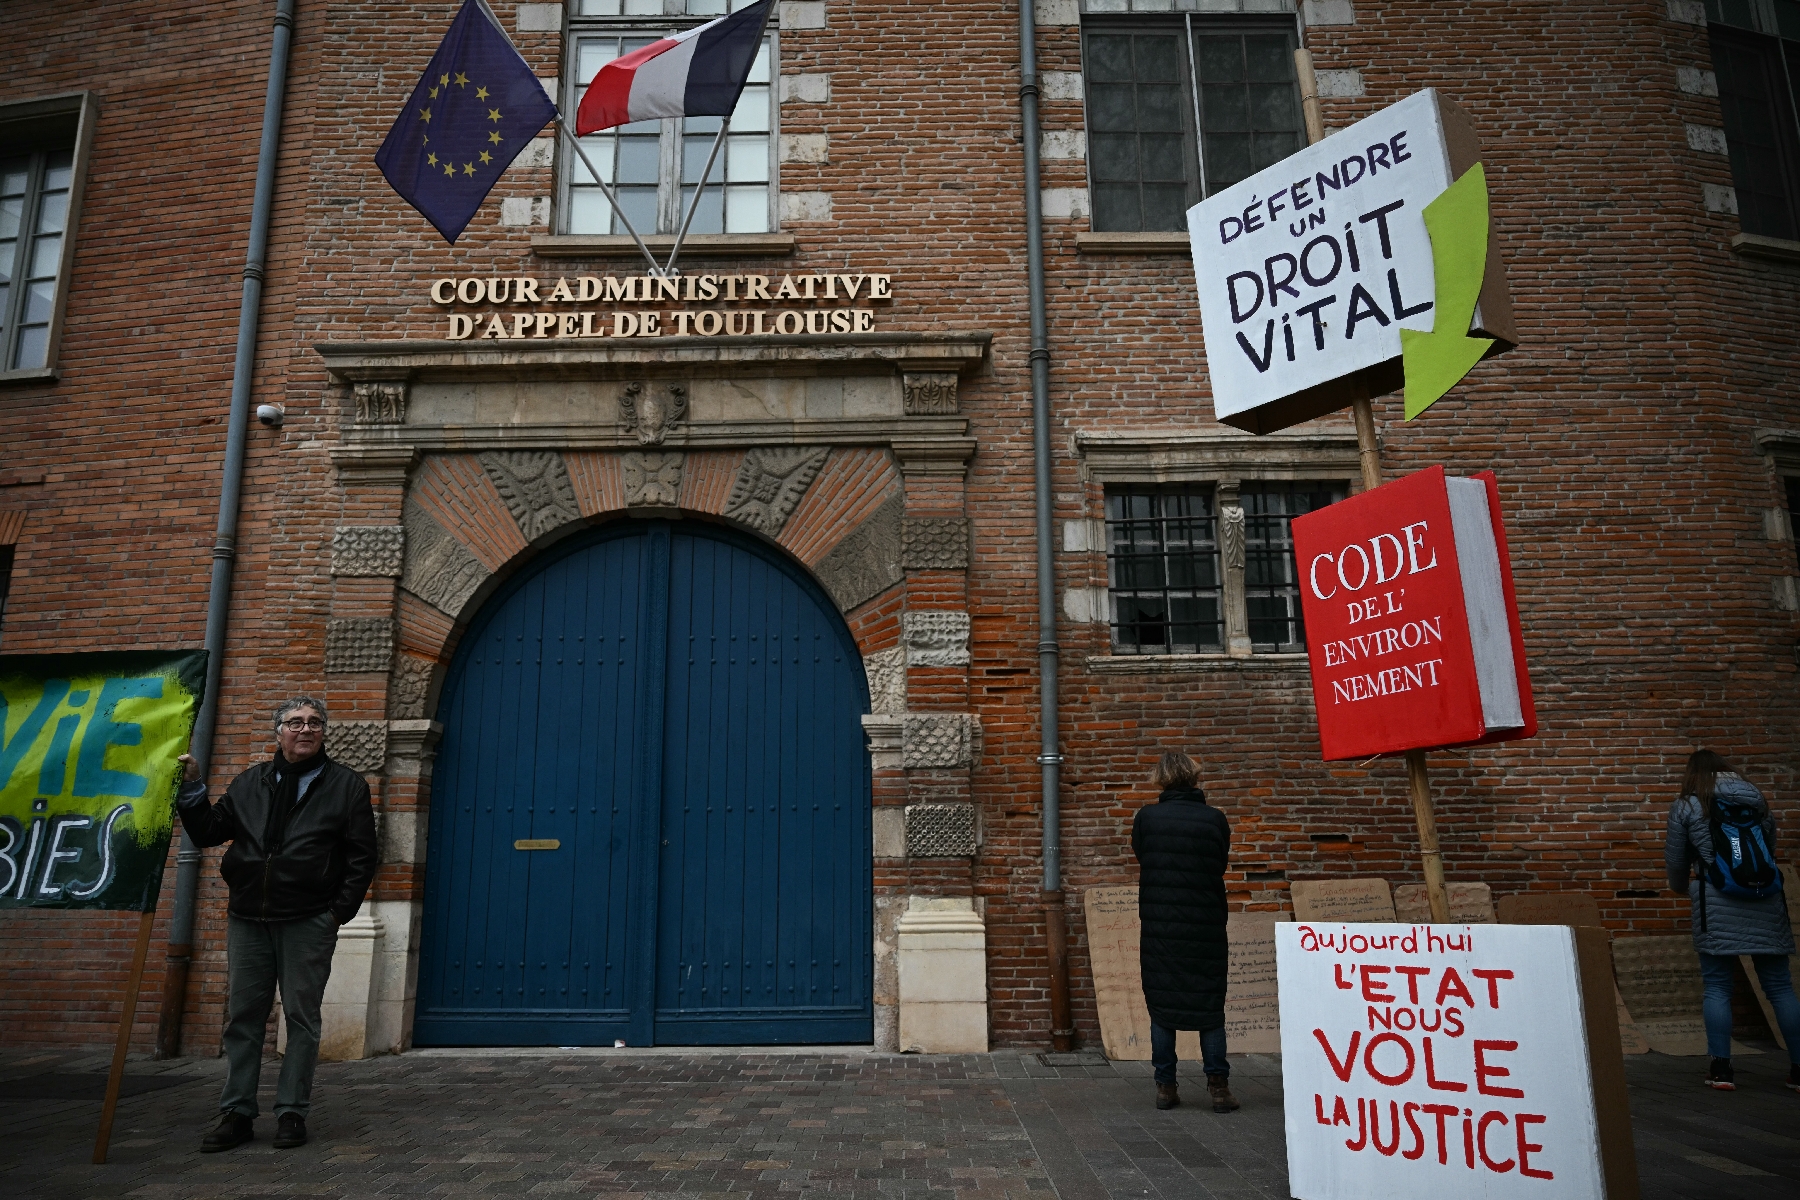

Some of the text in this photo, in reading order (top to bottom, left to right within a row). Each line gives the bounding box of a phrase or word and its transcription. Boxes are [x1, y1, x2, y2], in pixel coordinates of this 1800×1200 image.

[1219, 130, 1412, 244] DÉFENDRE
[1289, 207, 1326, 238] UN
[430, 273, 893, 304] COUR ADMINISTRATIVE
[445, 308, 876, 340] D'APPEL DE TOULOUSE
[1310, 520, 1438, 600] CODE
[1346, 588, 1406, 625] DE L'
[1322, 616, 1443, 667] ENVIRON
[1331, 658, 1443, 705] NEMENT
[1298, 925, 1473, 954] aujourd'hui
[1334, 963, 1515, 1009] L'ETAT
[1368, 1006, 1465, 1038] NOUS
[1312, 1028, 1525, 1099] VOLE
[1314, 1093, 1351, 1127] LA
